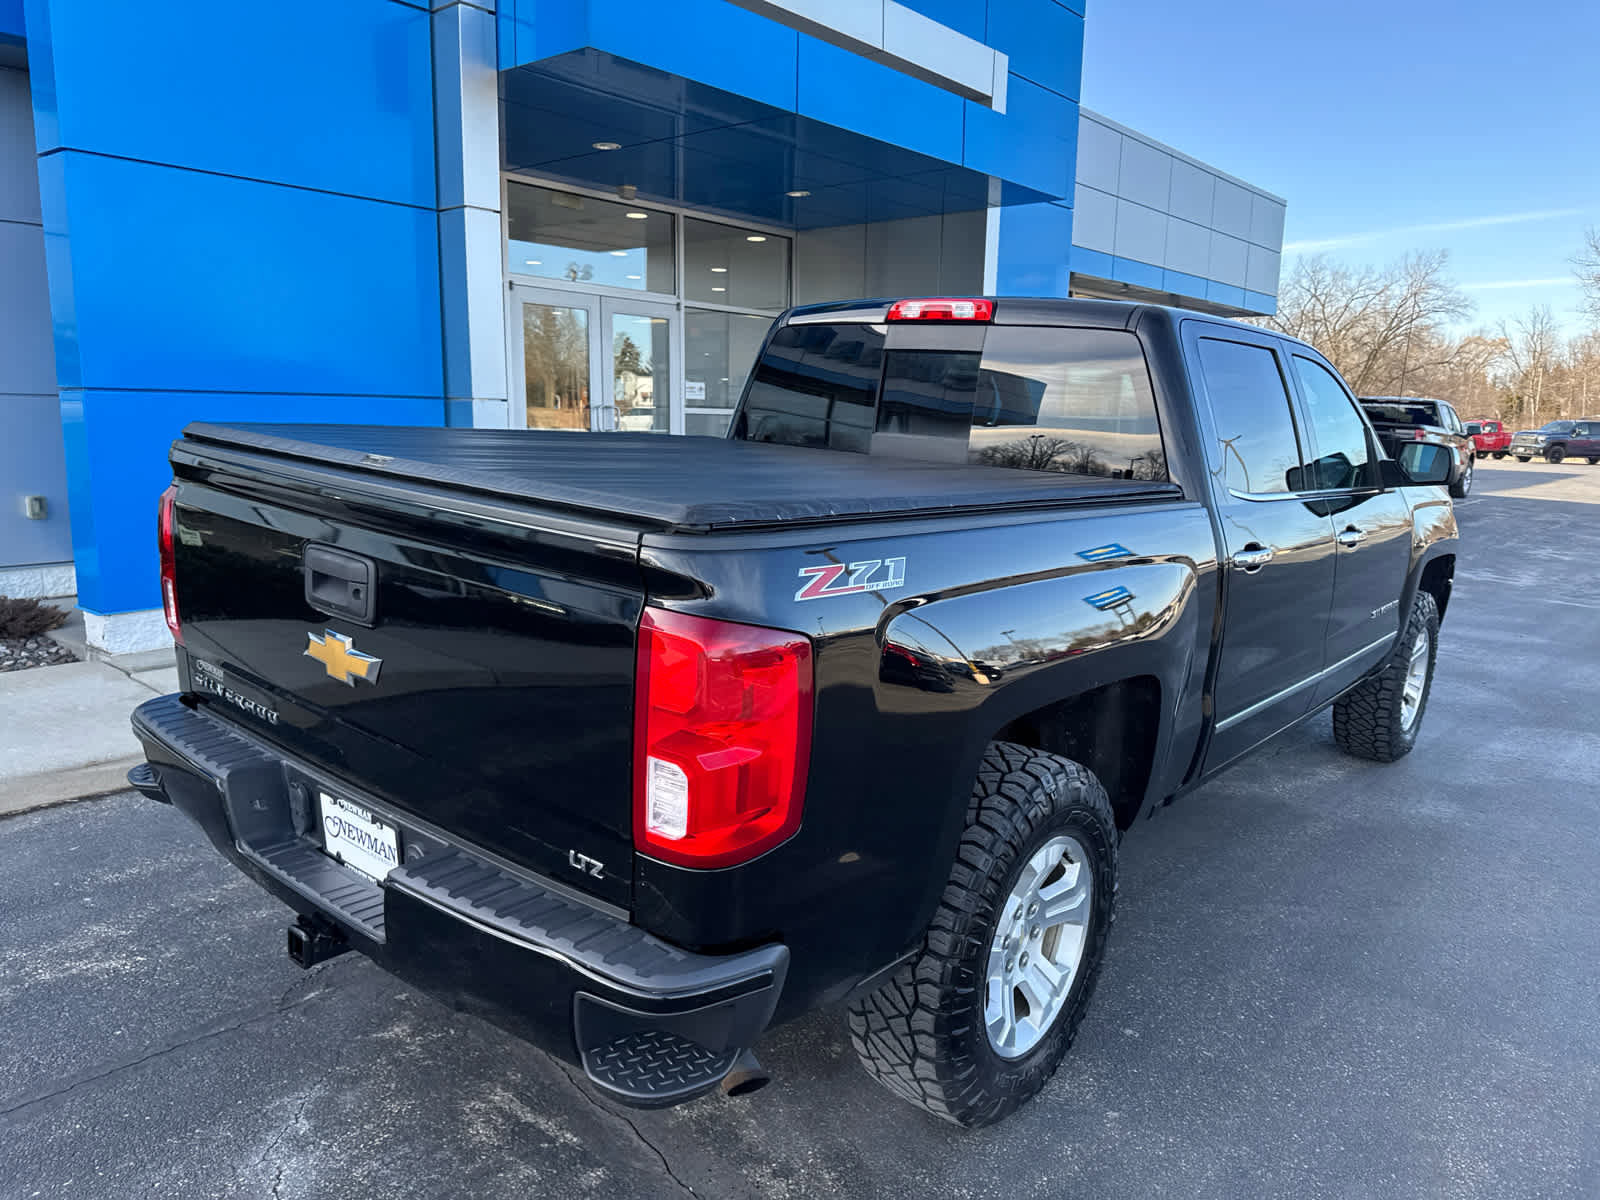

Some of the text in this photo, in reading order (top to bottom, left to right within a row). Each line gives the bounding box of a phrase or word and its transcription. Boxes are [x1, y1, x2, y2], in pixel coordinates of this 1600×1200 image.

[794, 557, 906, 602] Z71
[339, 817, 398, 863] NEWMAN
[569, 849, 604, 880] LTZ
